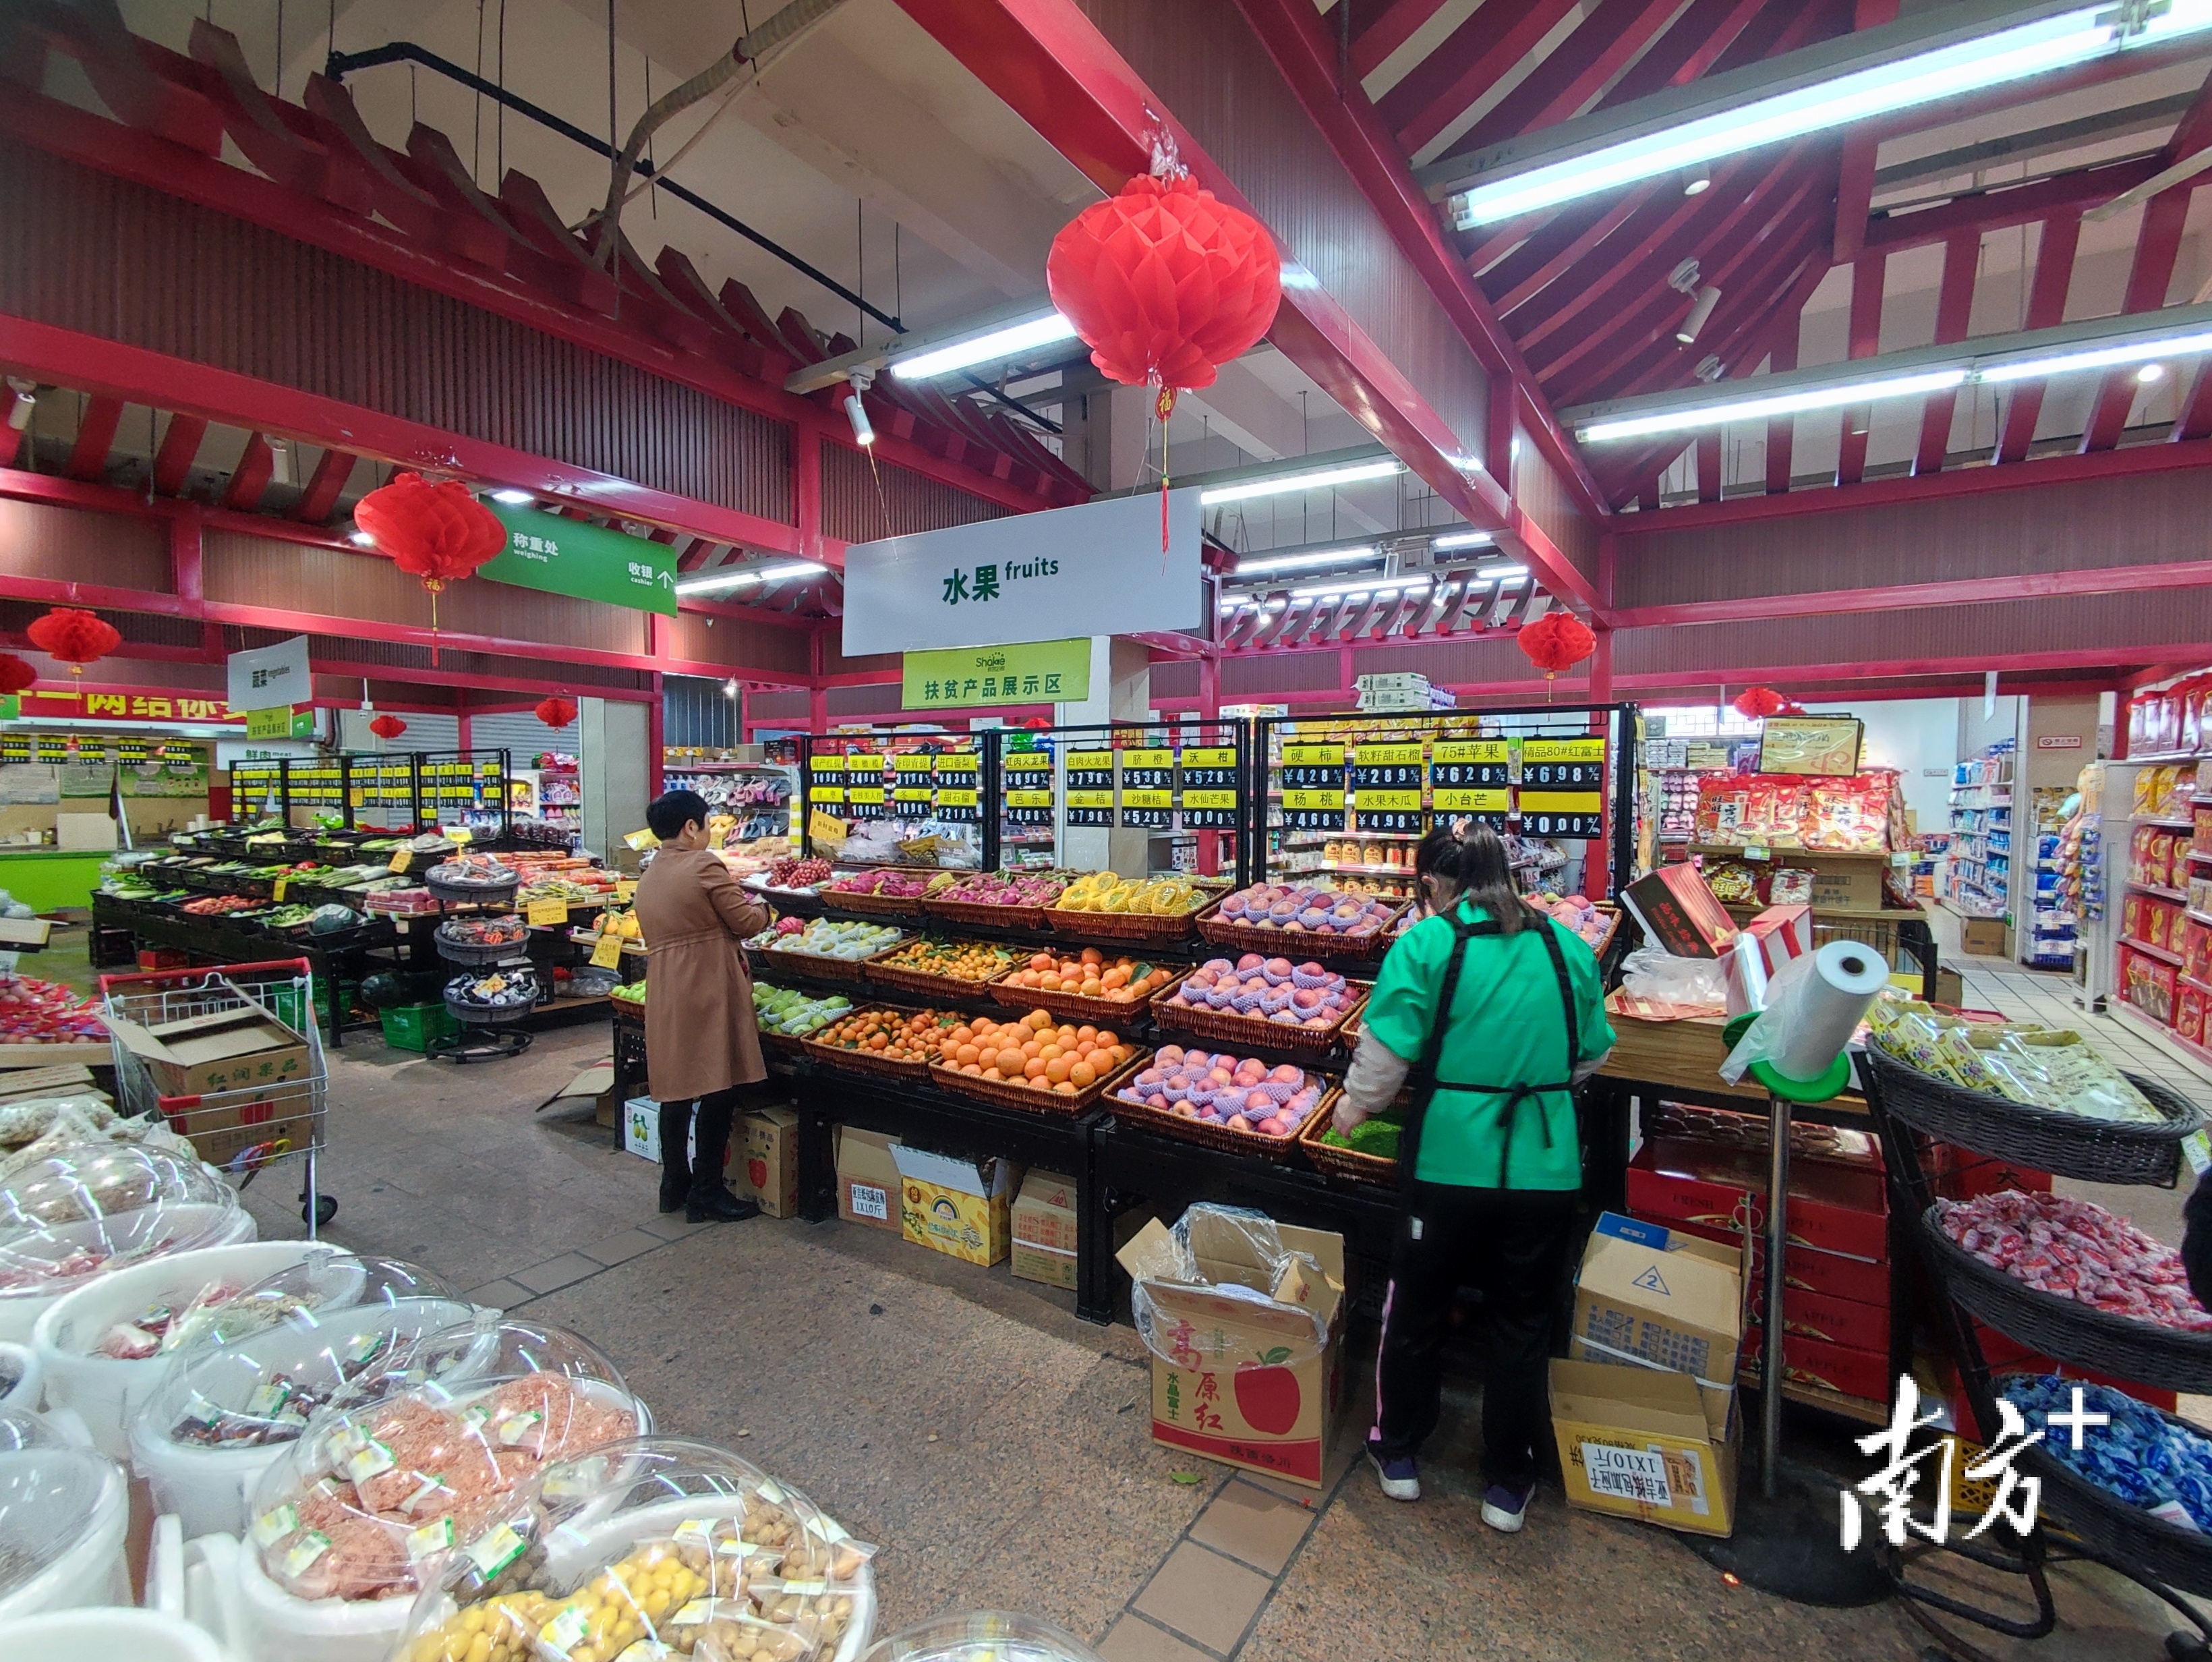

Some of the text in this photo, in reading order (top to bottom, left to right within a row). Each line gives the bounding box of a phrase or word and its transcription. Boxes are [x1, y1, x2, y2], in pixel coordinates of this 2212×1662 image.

[1159, 389, 1171, 414] 福
[513, 532, 559, 556] 称重处
[514, 548, 548, 562] weighing
[629, 561, 653, 579] 收银
[426, 578, 440, 591] 福
[631, 576, 653, 586] cashier
[942, 556, 1059, 605] 水果 fruits
[925, 673, 1062, 700] 扶贫产品展示区
[246, 749, 270, 760] 鲜肉
[1189, 751, 1228, 764] 沃柑
[1291, 747, 1332, 762] 硬柿
[1358, 749, 1420, 762] 软籽甜石榴
[1441, 743, 1500, 760] 75#苹果
[1524, 745, 1604, 758] 精品80#红富士
[895, 757, 927, 768] 香印青提
[937, 757, 970, 770] 进口香梨
[1006, 755, 1049, 766] 红肉火龙果
[1068, 755, 1110, 766] 白肉火龙果
[1132, 753, 1163, 765] 脐橙
[944, 792, 970, 803] 甜石榴
[1015, 793, 1041, 805] 芭乐
[1074, 793, 1106, 805] 金桔
[1132, 793, 1161, 805] 沙糖桔
[1190, 793, 1229, 805] 水仙芒果
[1293, 792, 1333, 806] 杨桃
[1363, 795, 1411, 807] 水果木瓜
[1445, 793, 1488, 806] 小台芒
[1054, 1196, 1064, 1204] 40
[856, 1201, 882, 1215] 1X10斤
[1646, 1275, 1657, 1288] 2
[1167, 1372, 1180, 1421] 水晶富士
[1594, 1448, 1657, 1474] 1X10斤
[1590, 1467, 1669, 1501] 亚吉纸包加应子
